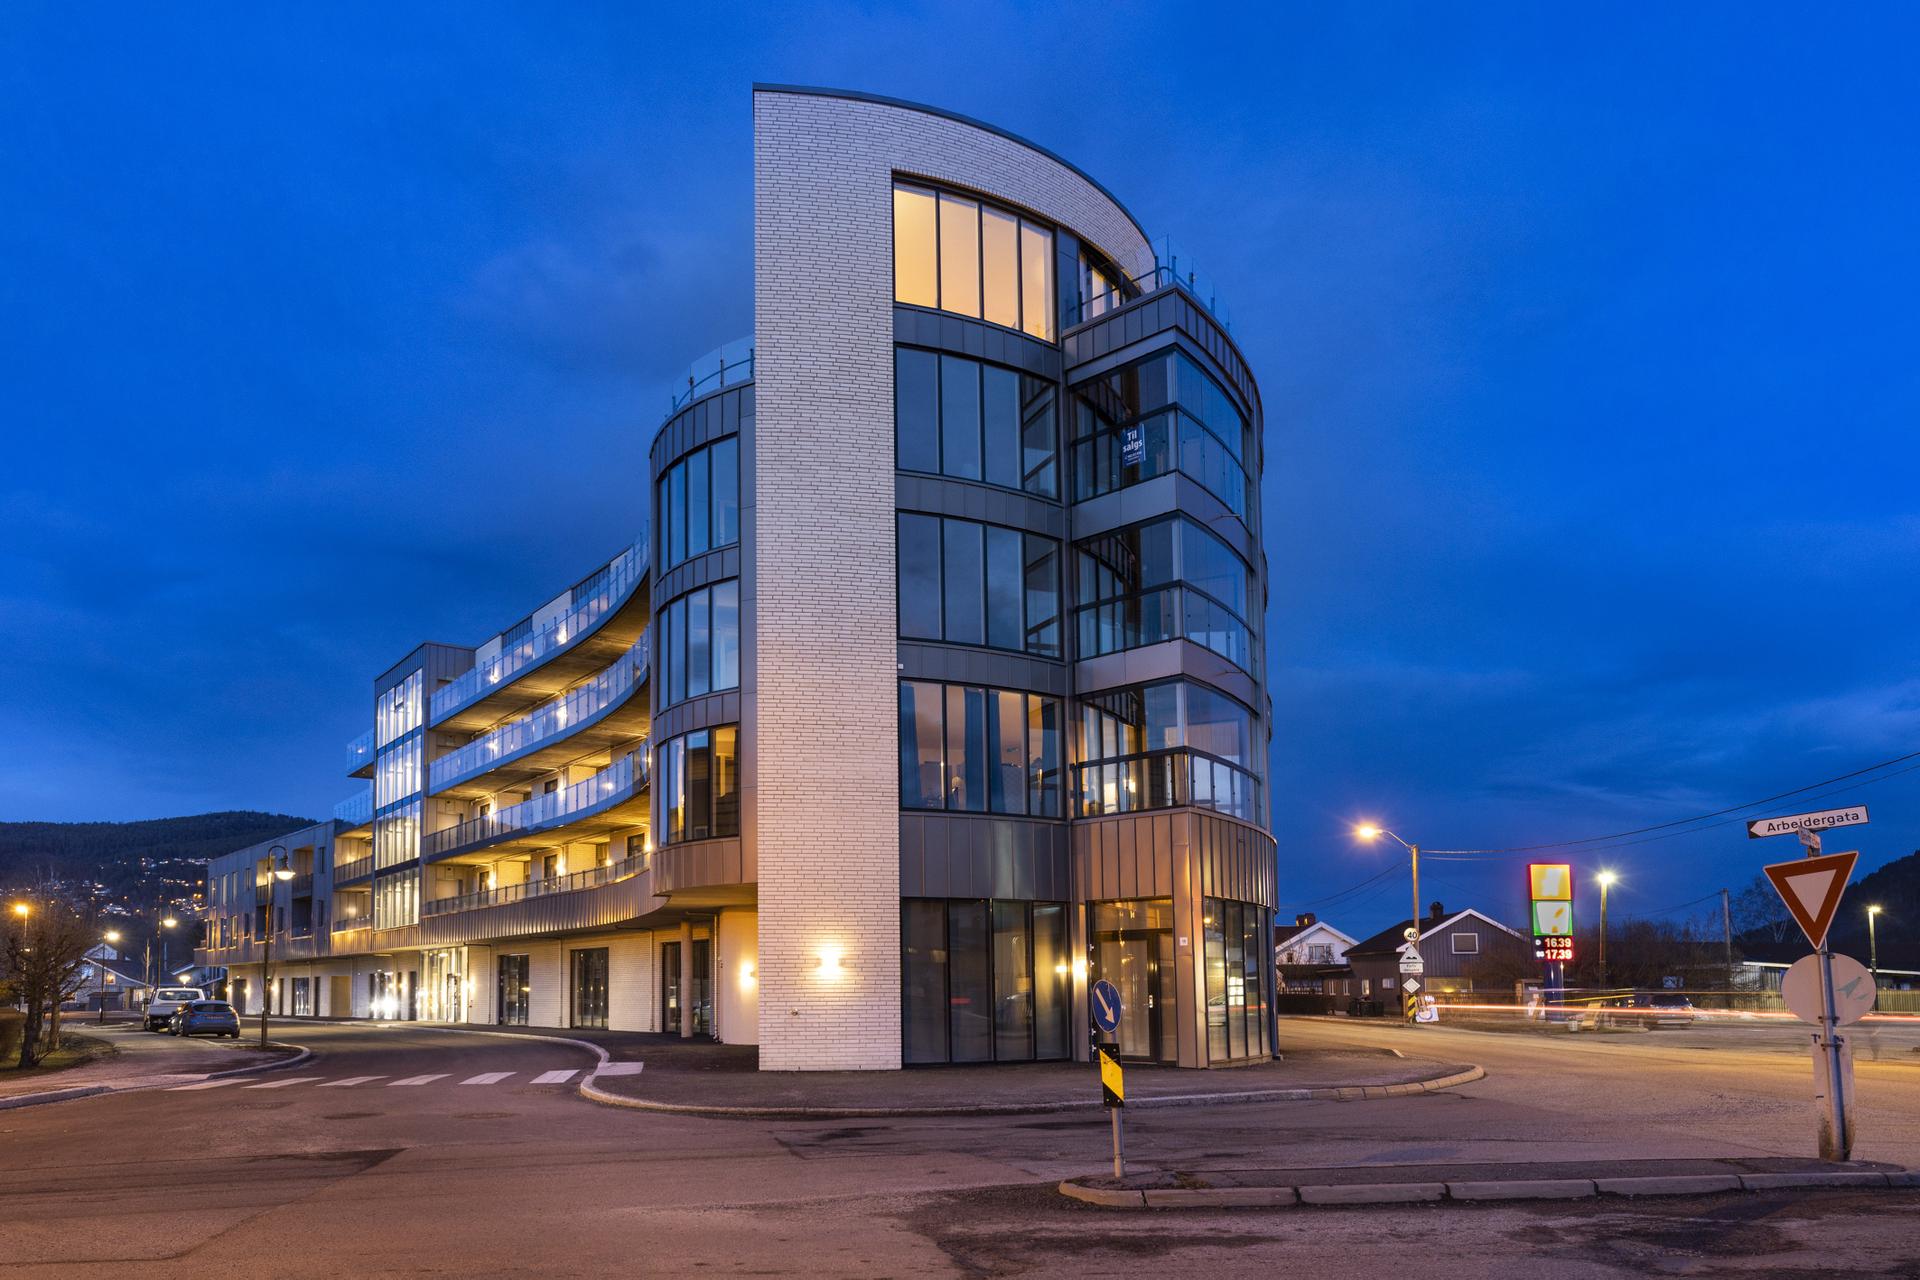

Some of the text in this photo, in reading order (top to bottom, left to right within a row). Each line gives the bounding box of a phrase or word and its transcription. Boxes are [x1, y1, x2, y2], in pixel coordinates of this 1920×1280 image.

[1127, 430, 1137, 441] Til
[1122, 439, 1143, 453] salgs
[1766, 812, 1860, 833] Arbeidergata
[1407, 931, 1417, 939] 40
[1545, 938, 1572, 948] 16.39
[1545, 949, 1572, 960] 17.39
